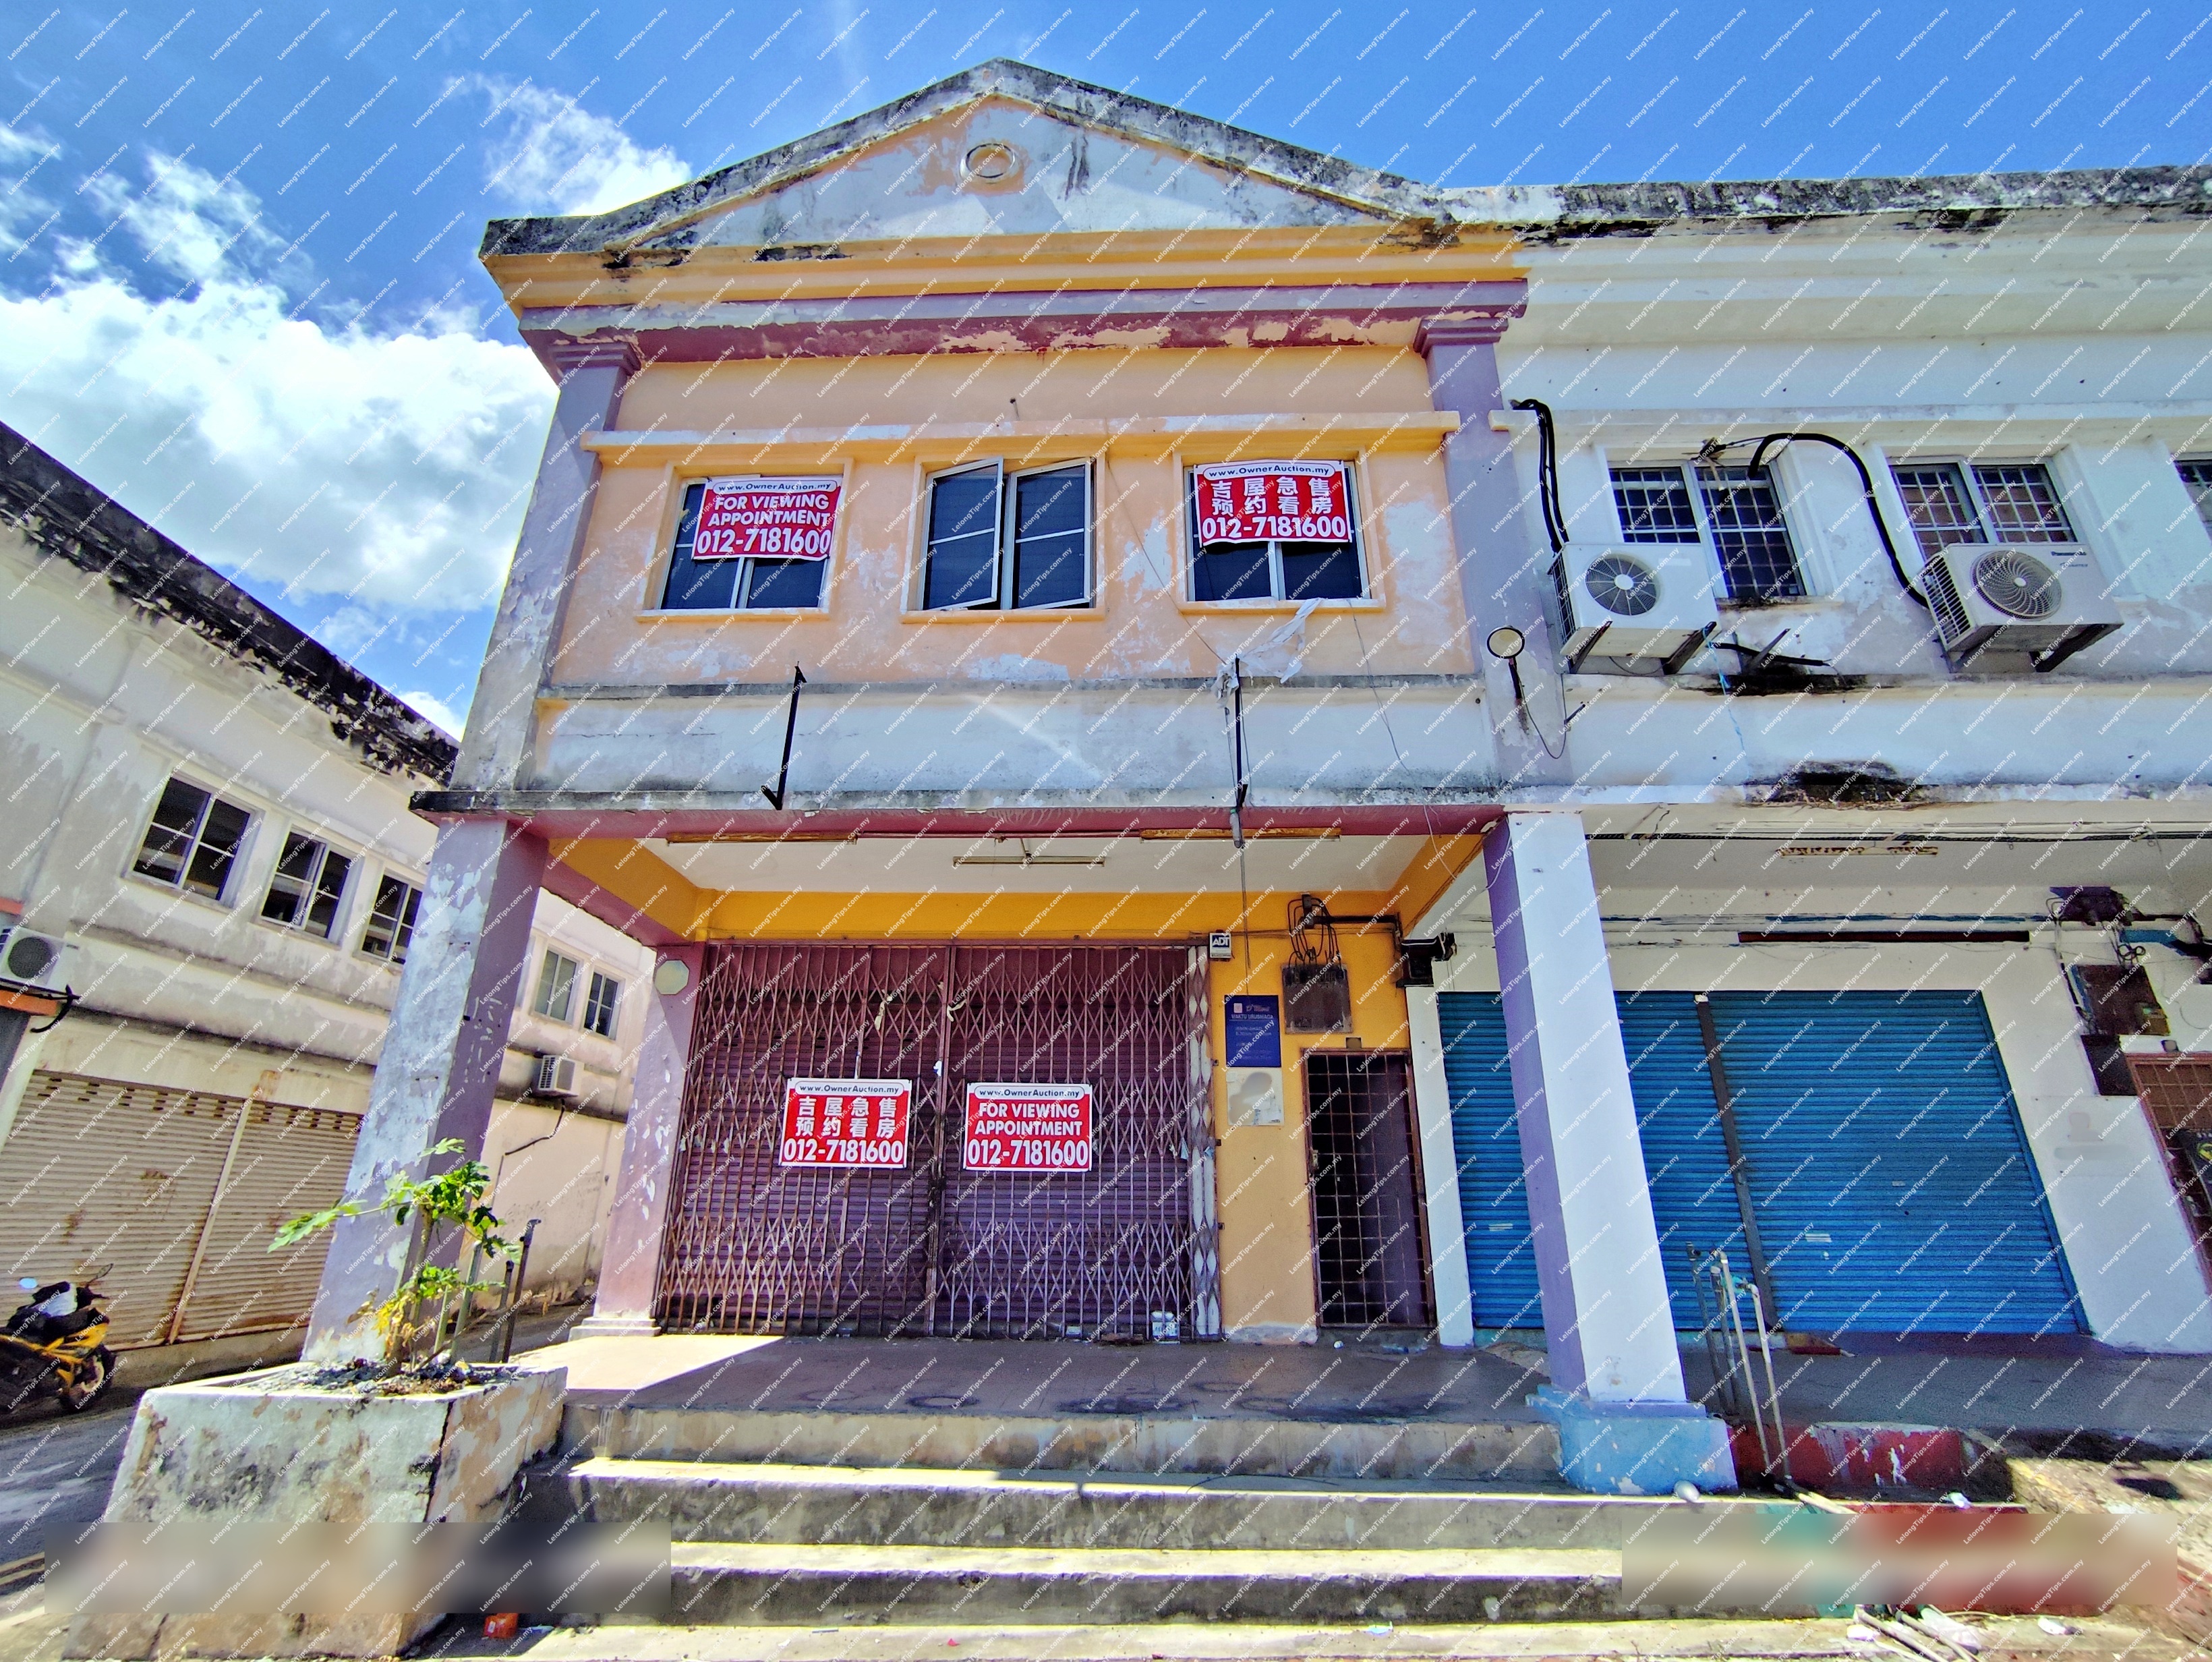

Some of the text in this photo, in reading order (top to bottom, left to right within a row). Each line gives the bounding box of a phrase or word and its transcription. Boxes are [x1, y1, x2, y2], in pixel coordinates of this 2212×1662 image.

[1209, 465, 1329, 476] www.OwnerAuction.my
[1211, 476, 1331, 498] 吉屋急售
[714, 494, 829, 511] FOR VIEWING
[1211, 496, 1333, 517] 预约看房
[708, 509, 830, 526] APPOINTMENT
[1202, 516, 1346, 539] 012-7181600
[697, 527, 832, 554] 012-7181600
[1212, 937, 1230, 946] ADT
[800, 1085, 899, 1094] www.OwnerAuction.my
[979, 1089, 1080, 1098] www.OwnerAuction.my
[798, 1096, 898, 1117] 吉屋急售
[979, 1103, 1080, 1118] FOR VIEWING
[795, 1116, 896, 1138] 预约看房
[974, 1120, 1083, 1136] APPOINTMENT
[784, 1139, 903, 1162] 012-7181600
[968, 1139, 1088, 1166] 012-7181600
